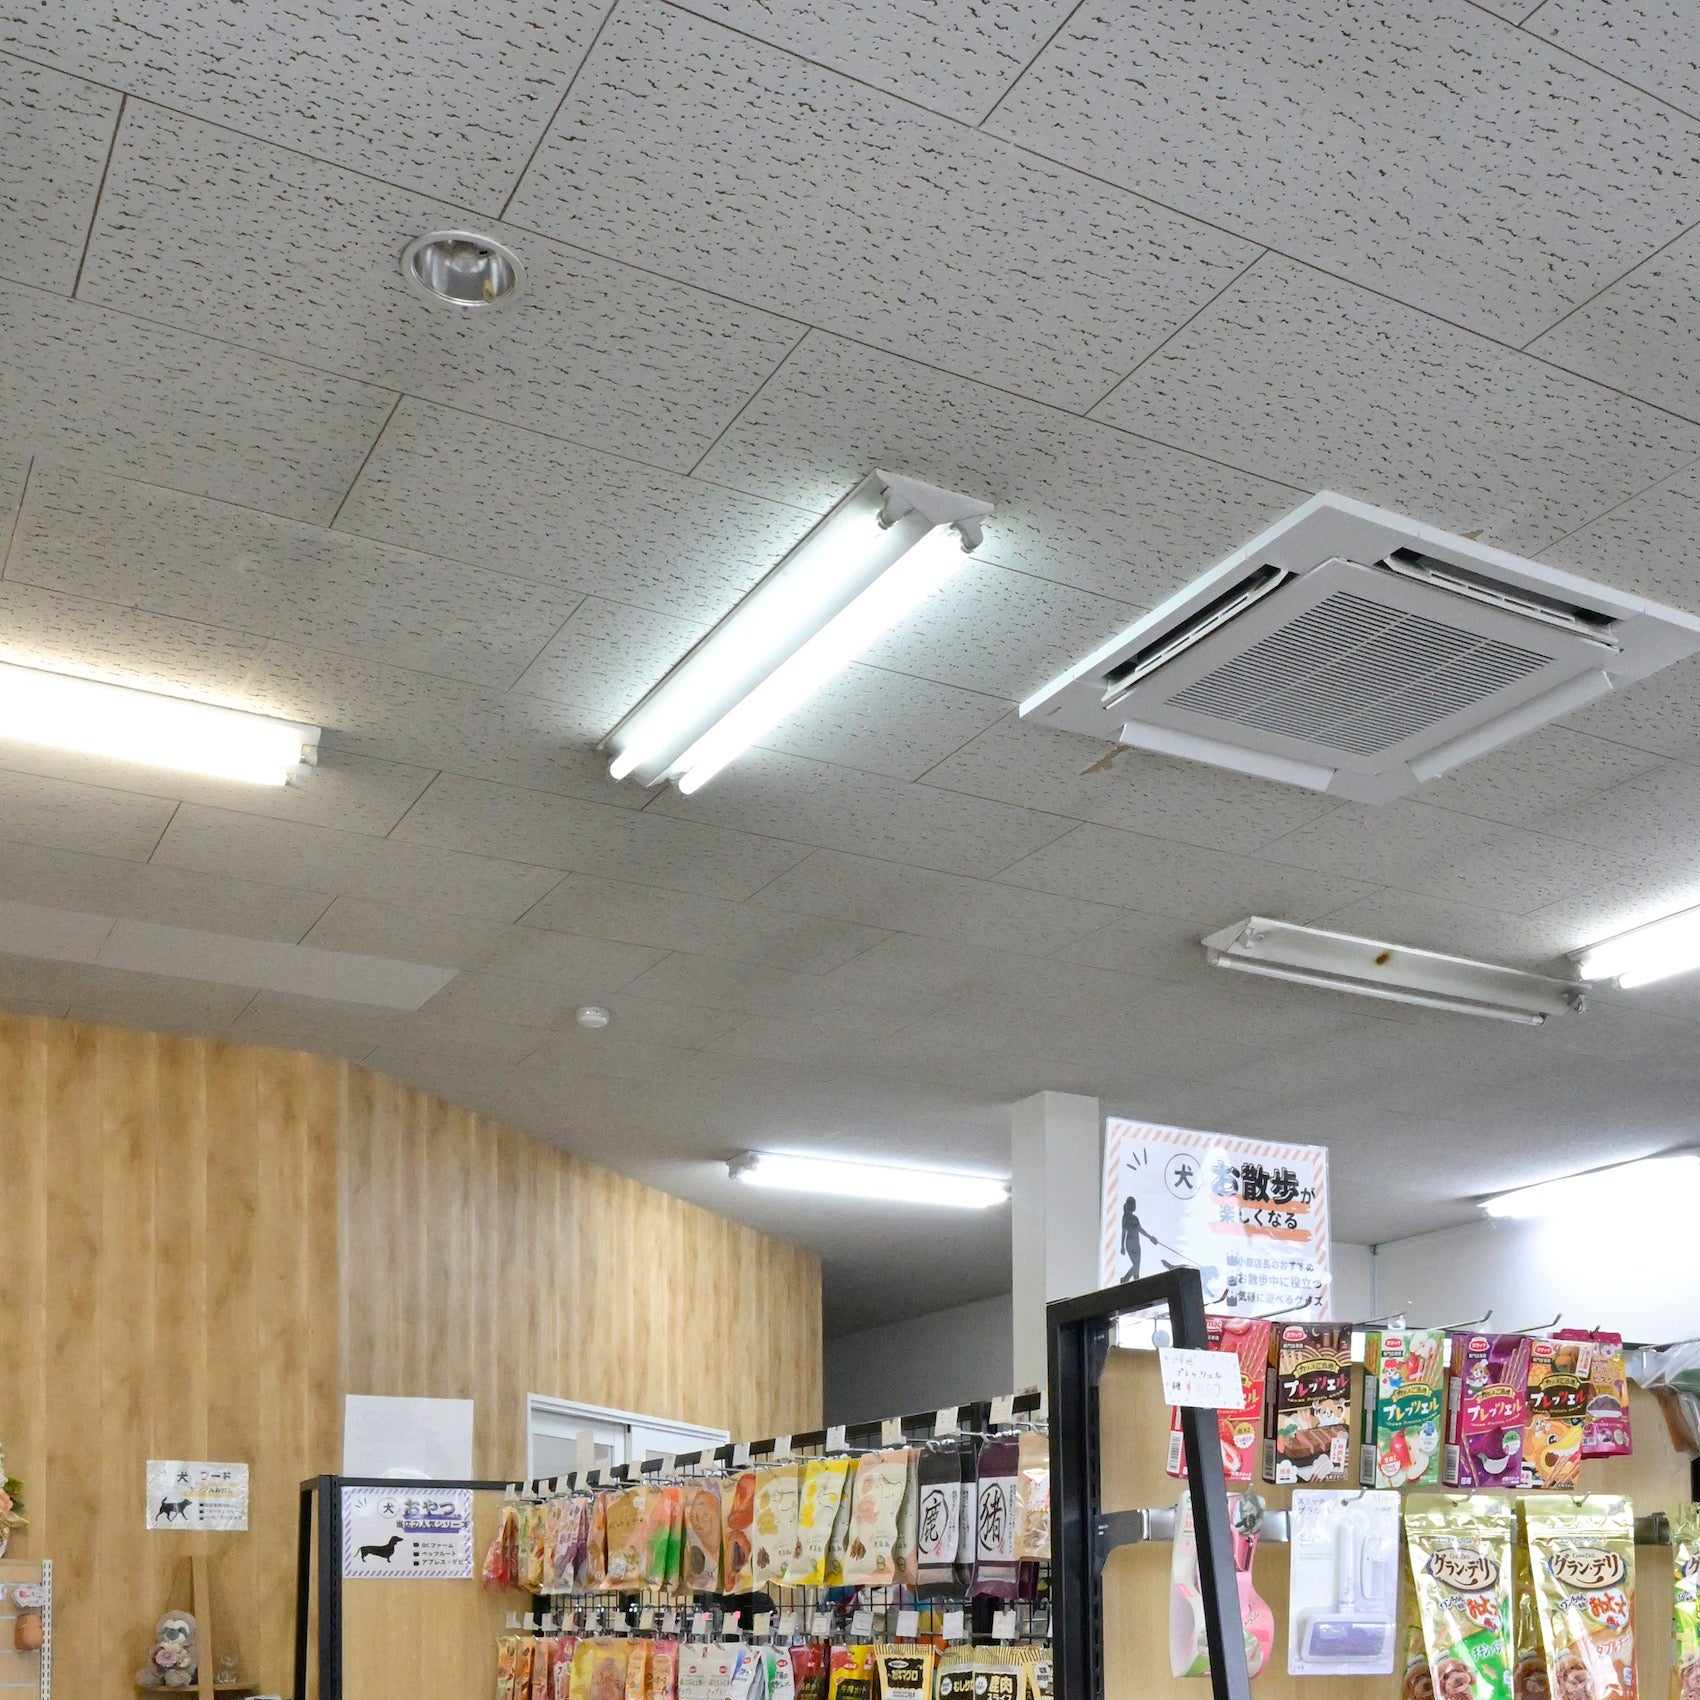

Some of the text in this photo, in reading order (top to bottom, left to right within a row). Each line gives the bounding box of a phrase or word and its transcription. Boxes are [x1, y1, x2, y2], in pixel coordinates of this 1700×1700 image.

[1173, 1163, 1194, 1190] 犬
[1210, 1159, 1316, 1206] お散歩が
[1218, 1203, 1299, 1230] 楽しくなる
[176, 1471, 189, 1483] 犬
[383, 1502, 394, 1514] 犬
[404, 1498, 456, 1516] おやつ
